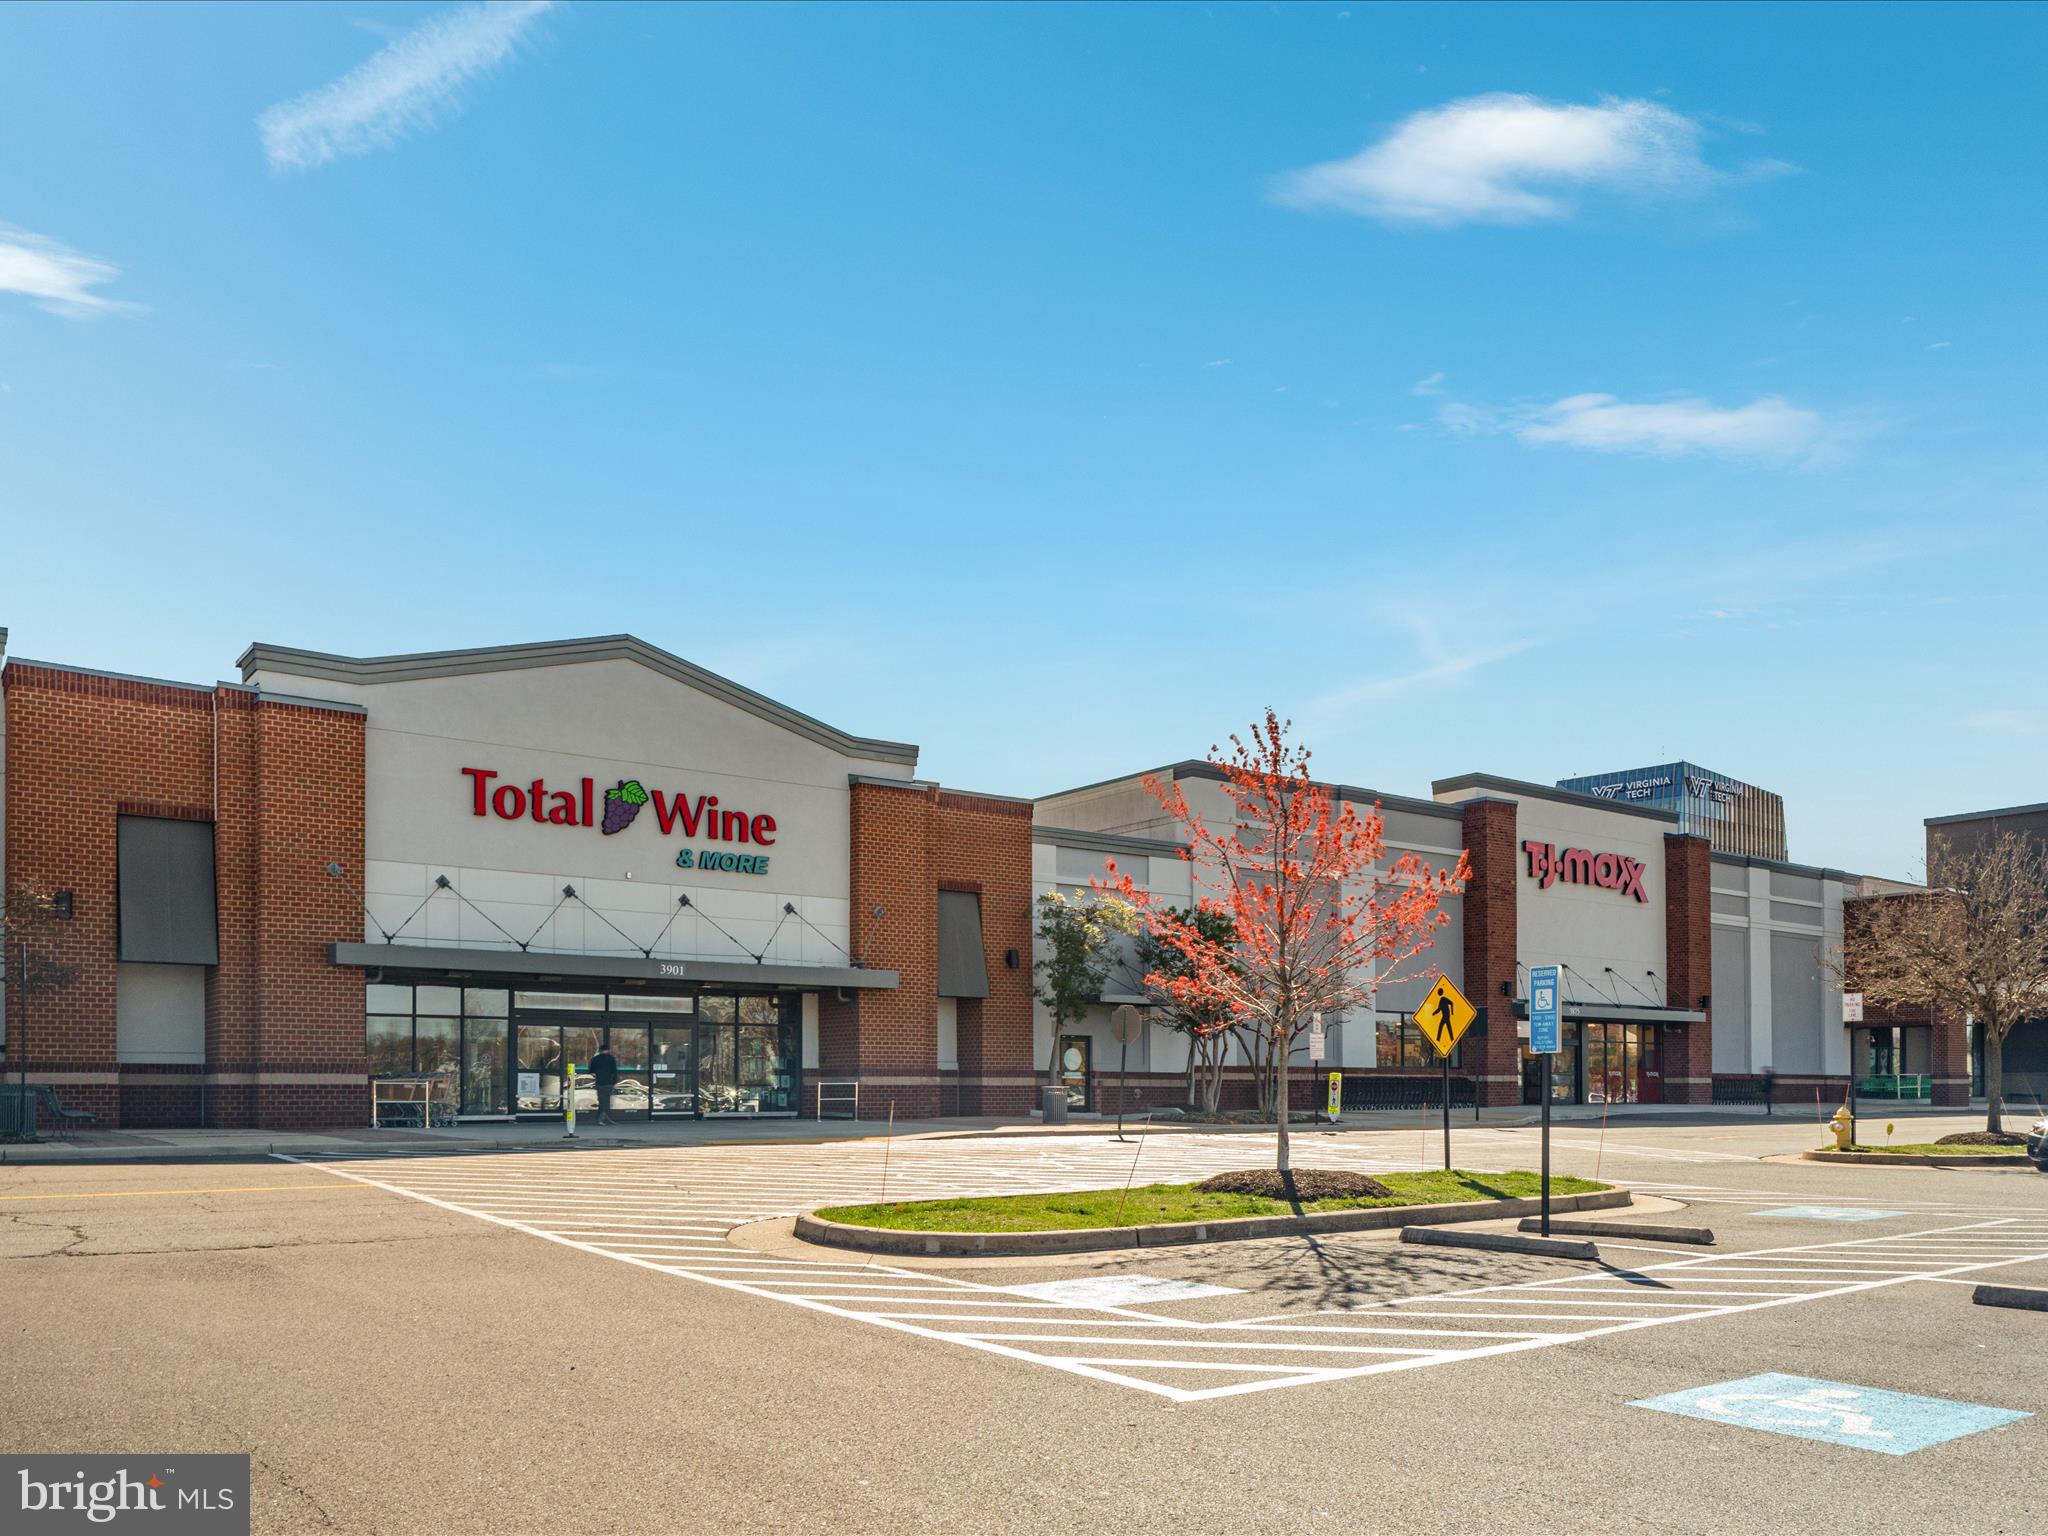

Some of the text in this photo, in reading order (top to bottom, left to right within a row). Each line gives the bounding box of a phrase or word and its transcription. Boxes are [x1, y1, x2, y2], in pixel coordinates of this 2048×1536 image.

[1626, 776, 1672, 790] VIRGINIA
[1713, 781, 1744, 797] VIRGINIA
[1626, 788, 1651, 799] TECH
[1712, 791, 1732, 803] TECH
[462, 767, 777, 846] Total Wine
[676, 848, 770, 875] & MORE
[660, 964, 684, 976] 3901
[1532, 969, 1557, 977] RESERVED
